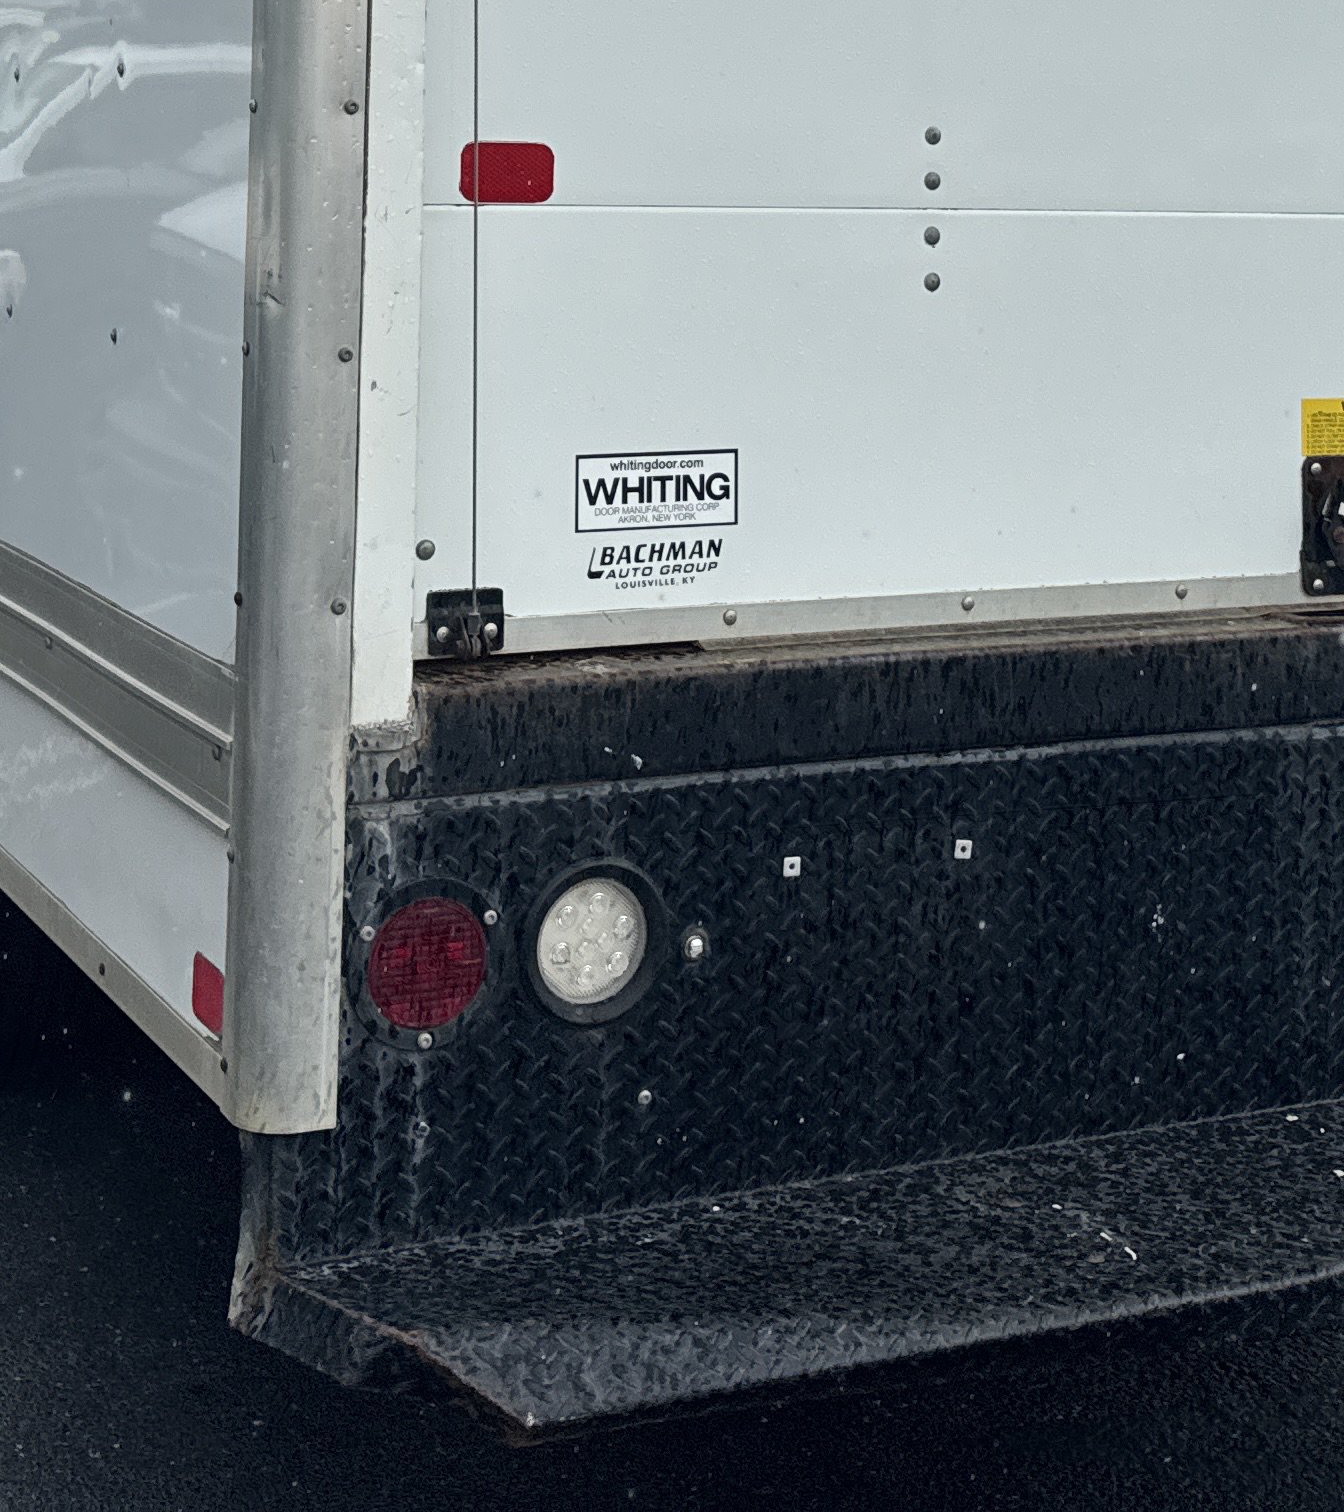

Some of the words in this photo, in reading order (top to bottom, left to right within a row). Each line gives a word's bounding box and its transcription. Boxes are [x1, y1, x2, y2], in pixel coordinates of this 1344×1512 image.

[609, 458, 704, 473] whitingdoor.com
[582, 472, 731, 506] WHITING
[594, 506, 620, 516] DOOR
[621, 503, 694, 515] MANUFACTURING
[652, 513, 671, 522] NEW
[673, 511, 697, 521] YORK
[599, 538, 723, 566] BACHMAN
[605, 566, 653, 580] AUTO
[659, 561, 719, 576] GROUP
[682, 575, 696, 585] KY
